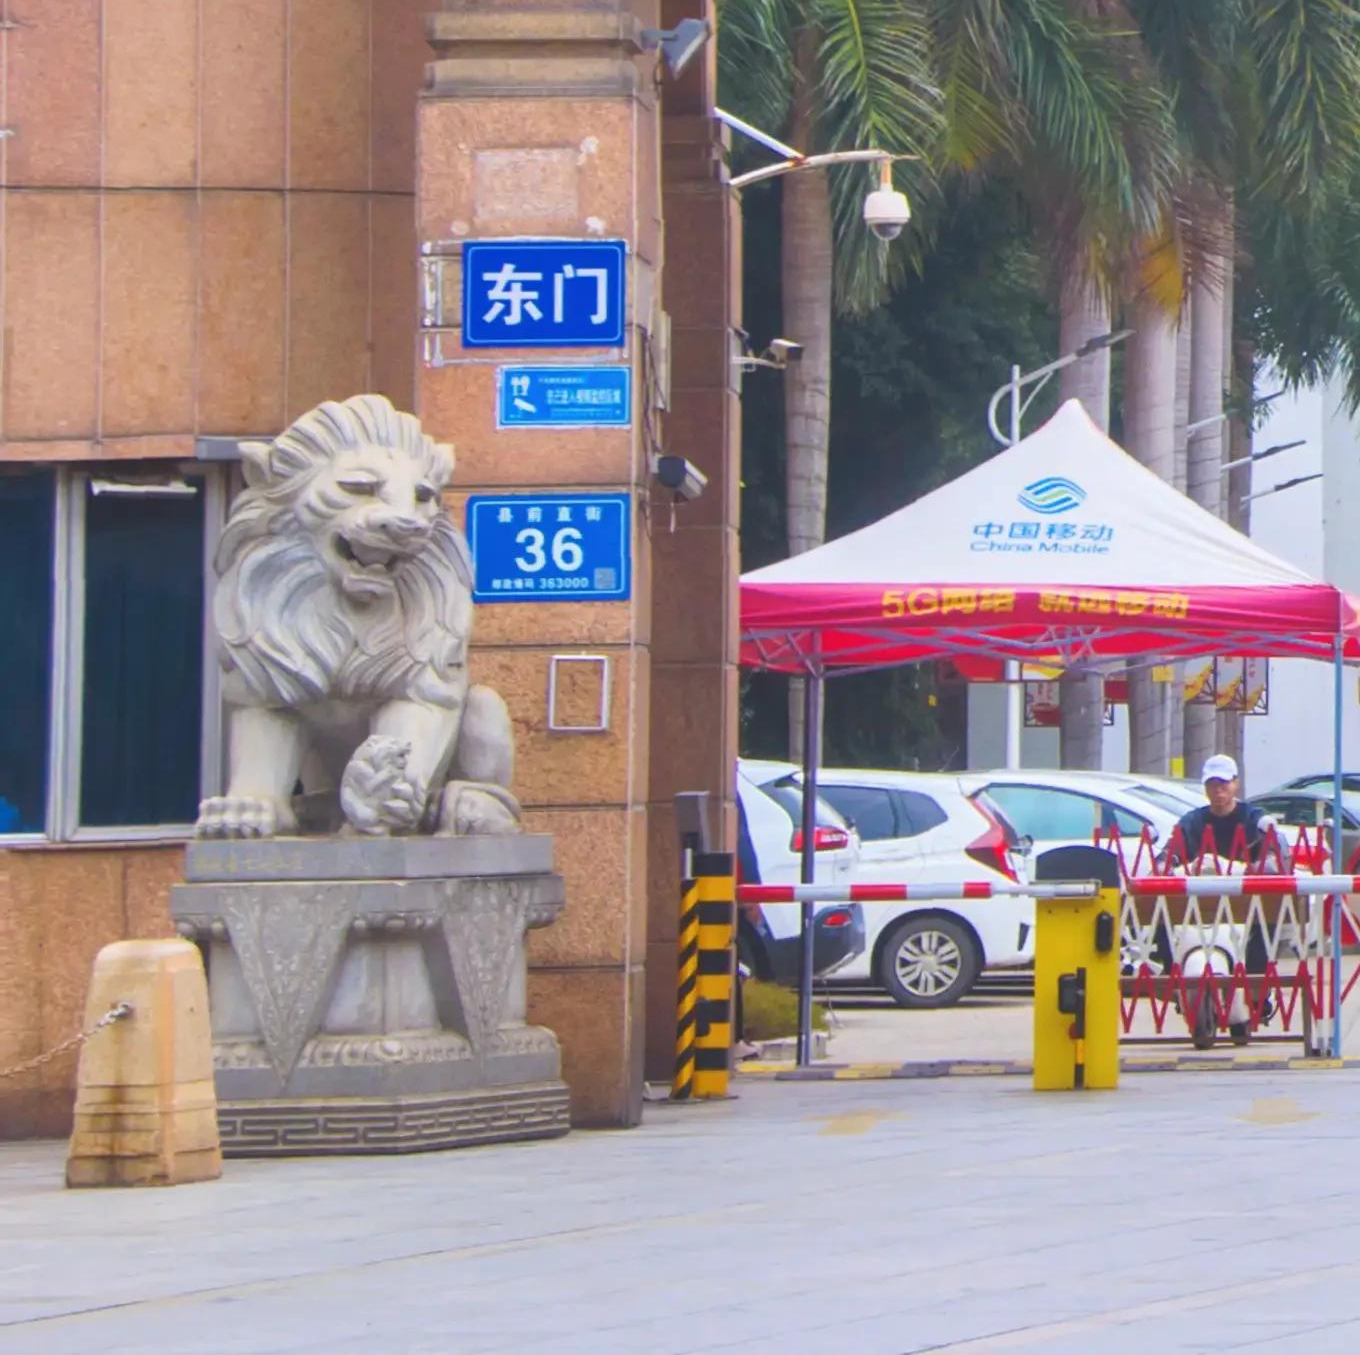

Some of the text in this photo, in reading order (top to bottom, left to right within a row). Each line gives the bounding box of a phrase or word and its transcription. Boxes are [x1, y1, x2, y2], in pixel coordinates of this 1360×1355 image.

[482, 262, 608, 325] 东门
[973, 522, 1114, 541] 中国移动
[515, 527, 584, 573] 36
[970, 540, 1110, 554] China Mobile
[539, 577, 590, 589] 363000
[881, 587, 1014, 617] 5G网络
